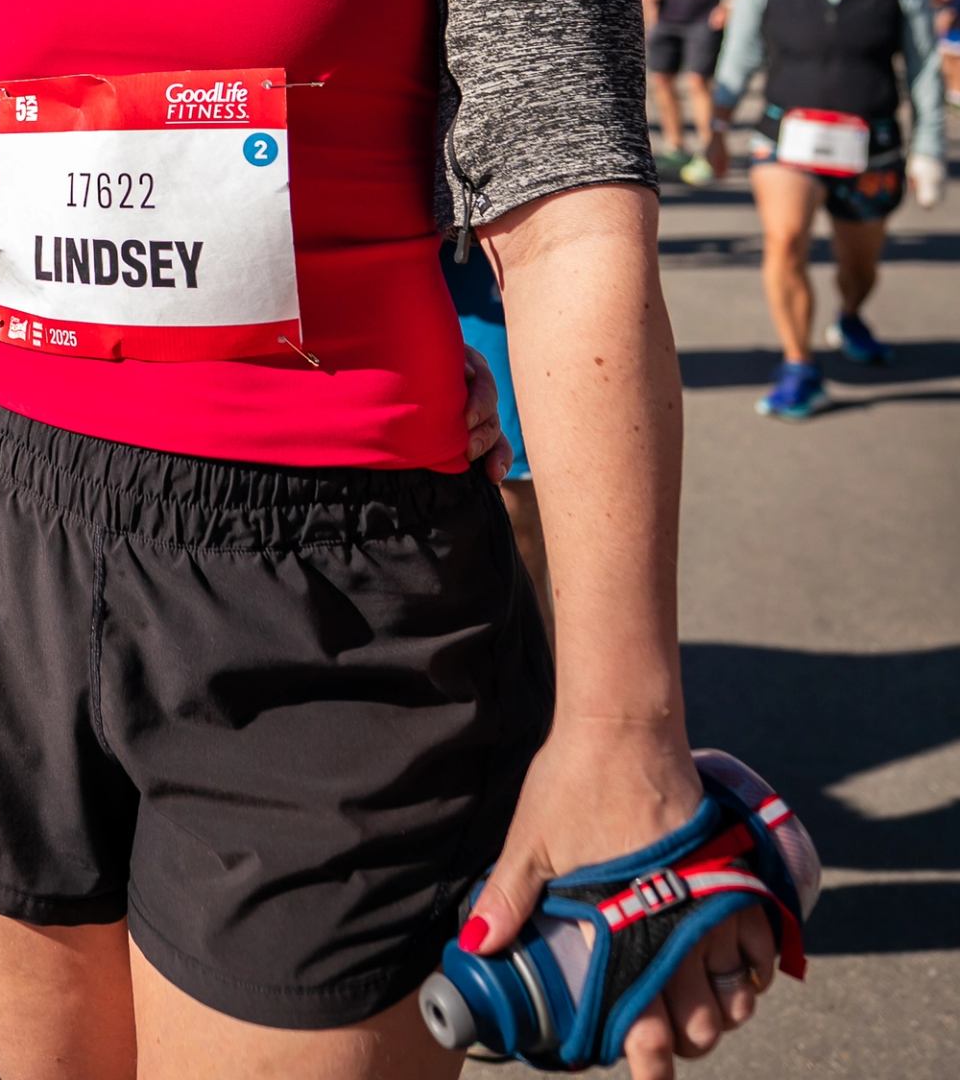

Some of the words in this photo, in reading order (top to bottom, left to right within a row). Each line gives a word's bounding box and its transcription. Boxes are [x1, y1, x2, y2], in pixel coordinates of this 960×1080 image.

[165, 81, 248, 103] GoodLife
[253, 139, 268, 160] 2
[67, 172, 155, 209] 17622
[34, 235, 204, 289] LINDSEY
[49, 328, 78, 347] 2025
